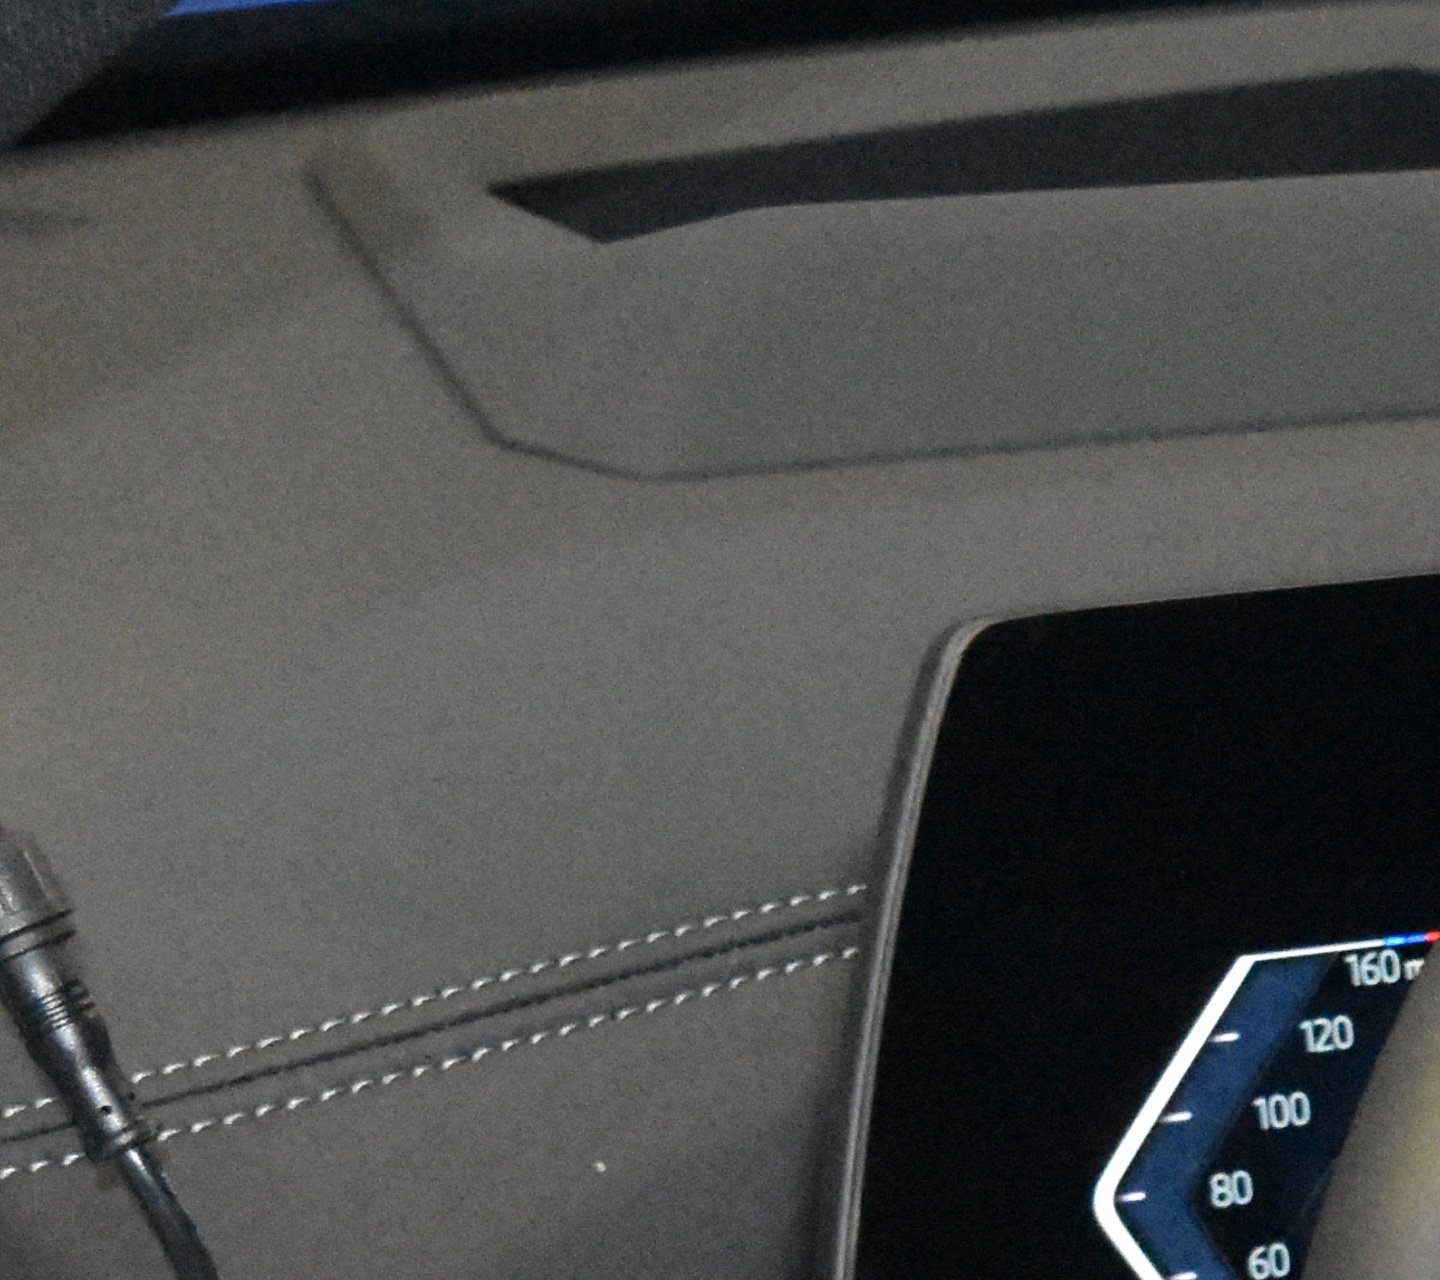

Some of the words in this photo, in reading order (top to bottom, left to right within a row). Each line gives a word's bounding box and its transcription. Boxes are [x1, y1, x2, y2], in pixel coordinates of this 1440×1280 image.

[1345, 948, 1401, 987] 160
[1299, 1013, 1356, 1054] 120
[1251, 1090, 1312, 1131] 100
[1208, 1169, 1254, 1209] 80
